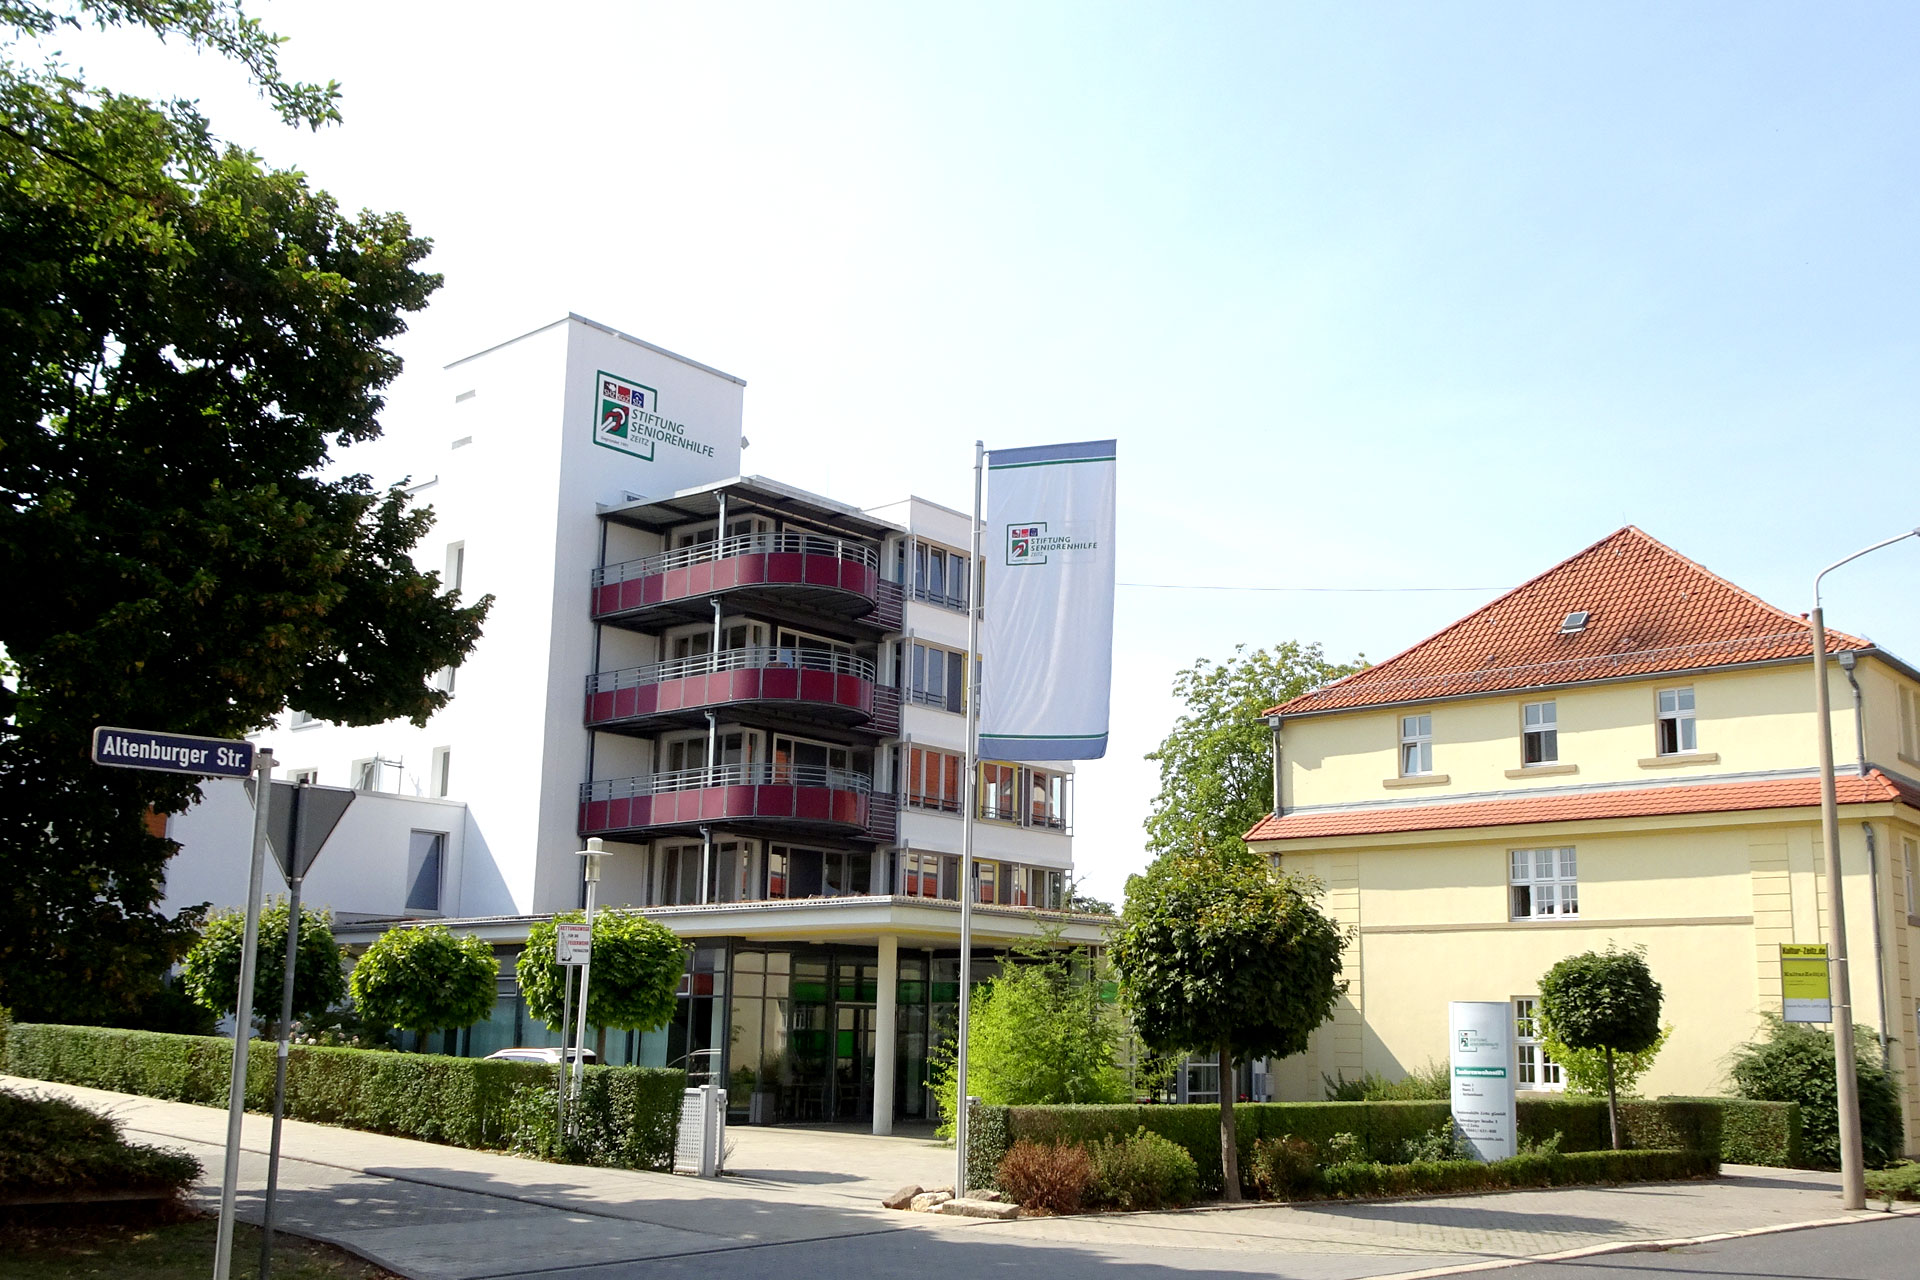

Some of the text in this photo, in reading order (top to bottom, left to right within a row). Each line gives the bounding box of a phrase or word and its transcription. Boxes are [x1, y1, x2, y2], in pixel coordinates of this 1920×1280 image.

[631, 408, 684, 435] STIFTUNG
[630, 434, 649, 447] ZEITZ
[631, 421, 714, 458] SENIORENHILFE
[1030, 536, 1071, 545] STIFTUNG
[1030, 542, 1098, 552] SENIORENHILFE
[102, 735, 246, 768] Altenburger Str.
[1782, 946, 1826, 955] Kultur-Zeitz.de
